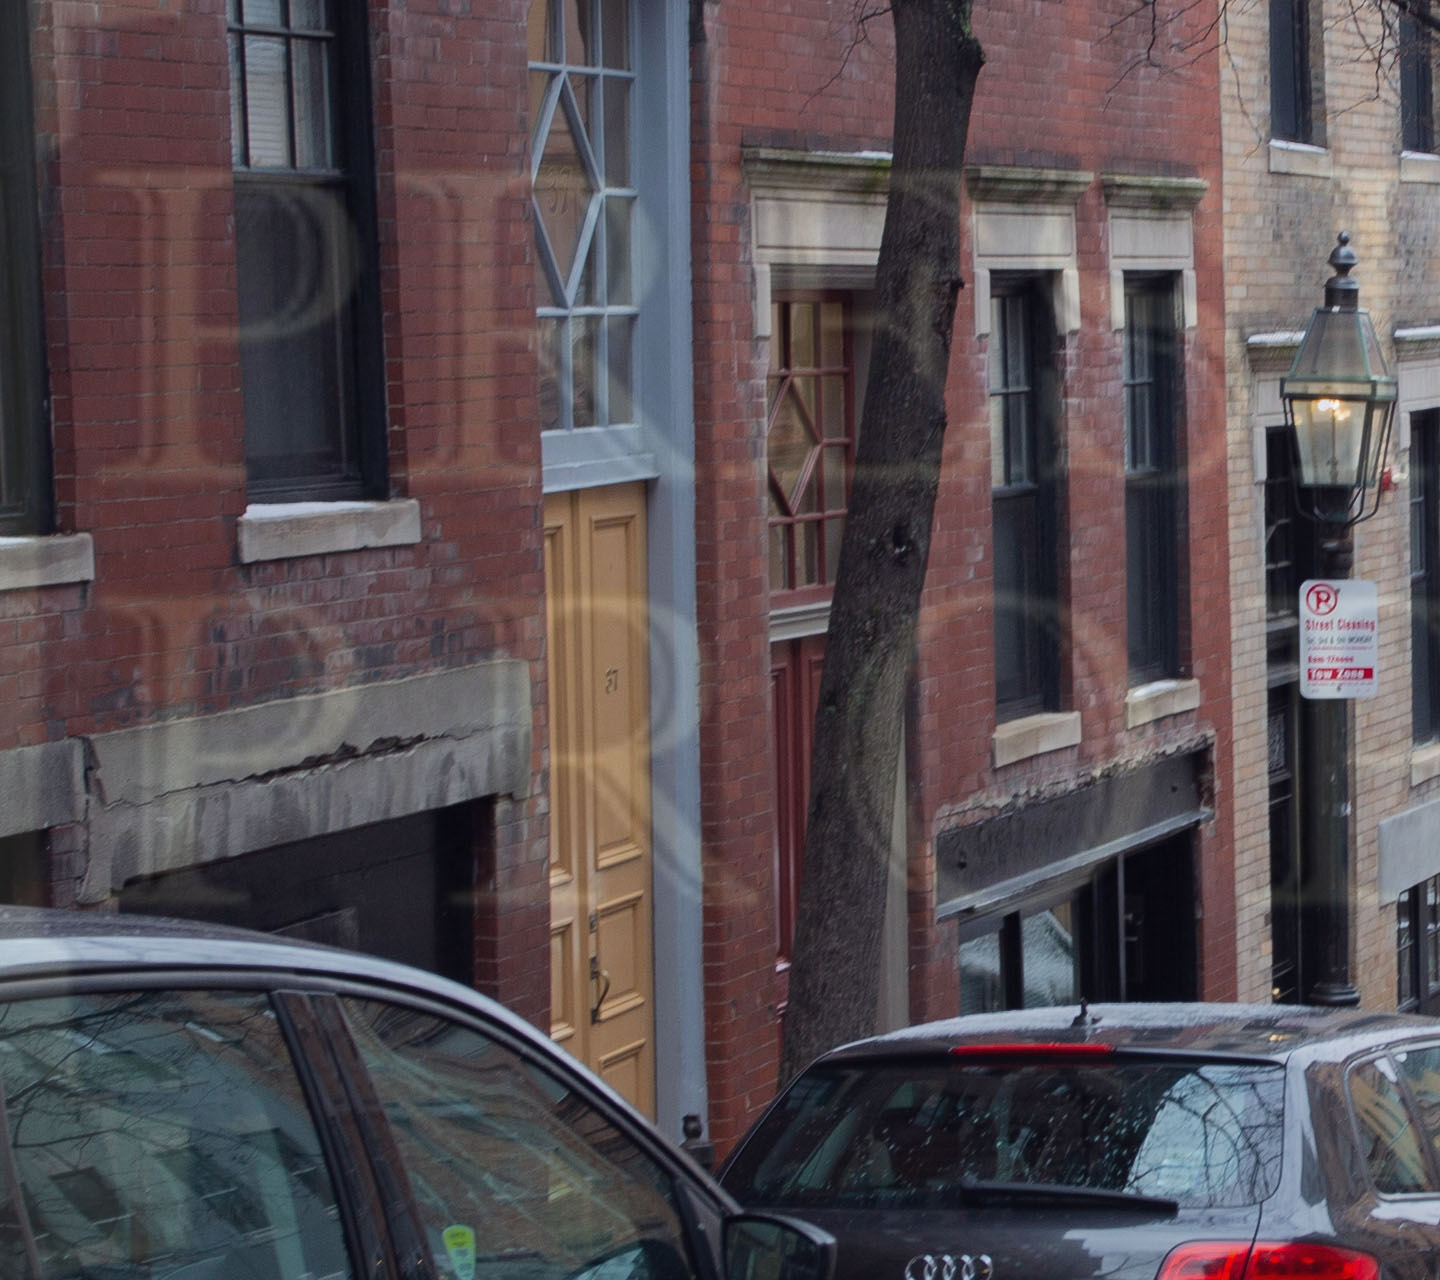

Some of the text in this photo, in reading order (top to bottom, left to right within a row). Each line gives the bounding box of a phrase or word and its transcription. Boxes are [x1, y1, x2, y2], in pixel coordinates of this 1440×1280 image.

[1305, 619, 1376, 632] Street Cleaning
[1311, 668, 1364, 680] Tow Zone
